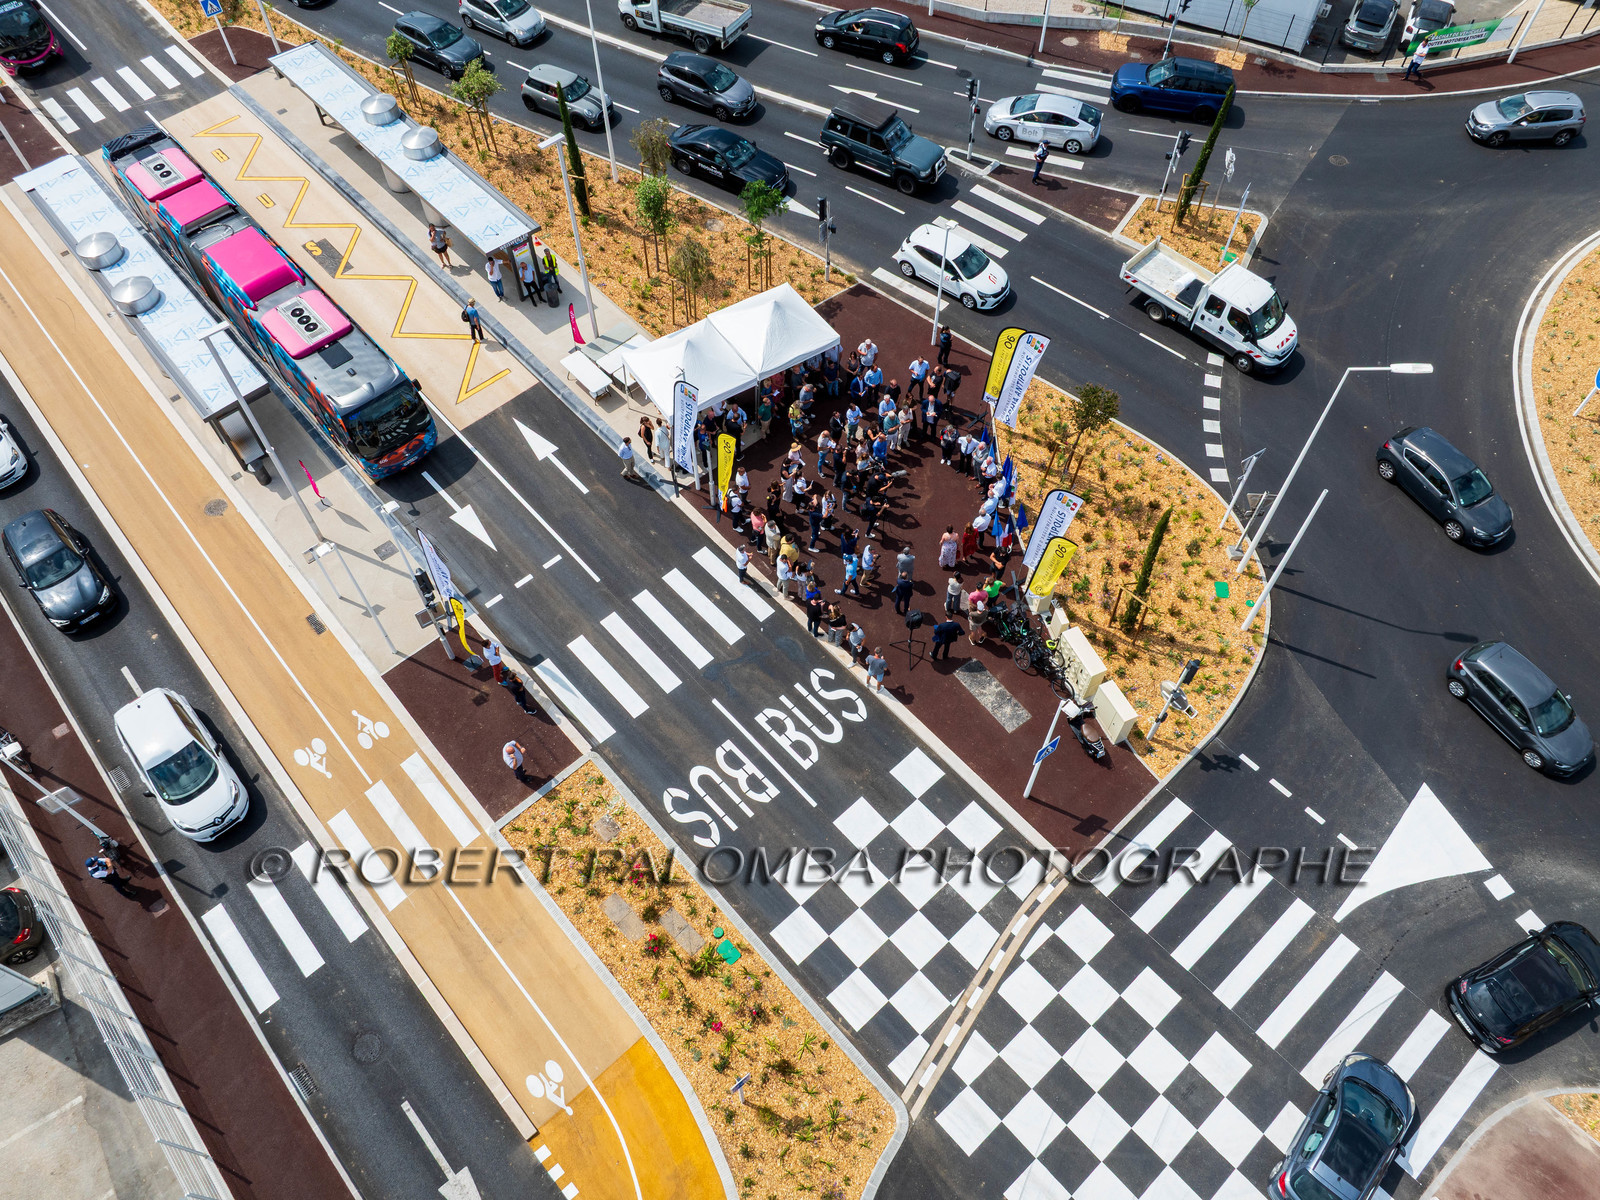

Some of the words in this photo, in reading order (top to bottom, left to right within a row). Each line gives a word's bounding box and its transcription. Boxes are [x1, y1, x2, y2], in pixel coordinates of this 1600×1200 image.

[1442, 33, 1484, 43] MOTORISATIONS
[1021, 127, 1039, 137] Bolt
[1004, 335, 1016, 350] 06
[1015, 355, 1032, 397] ANTIPOLIS
[1054, 544, 1067, 558] 06
[754, 668, 867, 770] BUS
[663, 739, 781, 848] BUS
